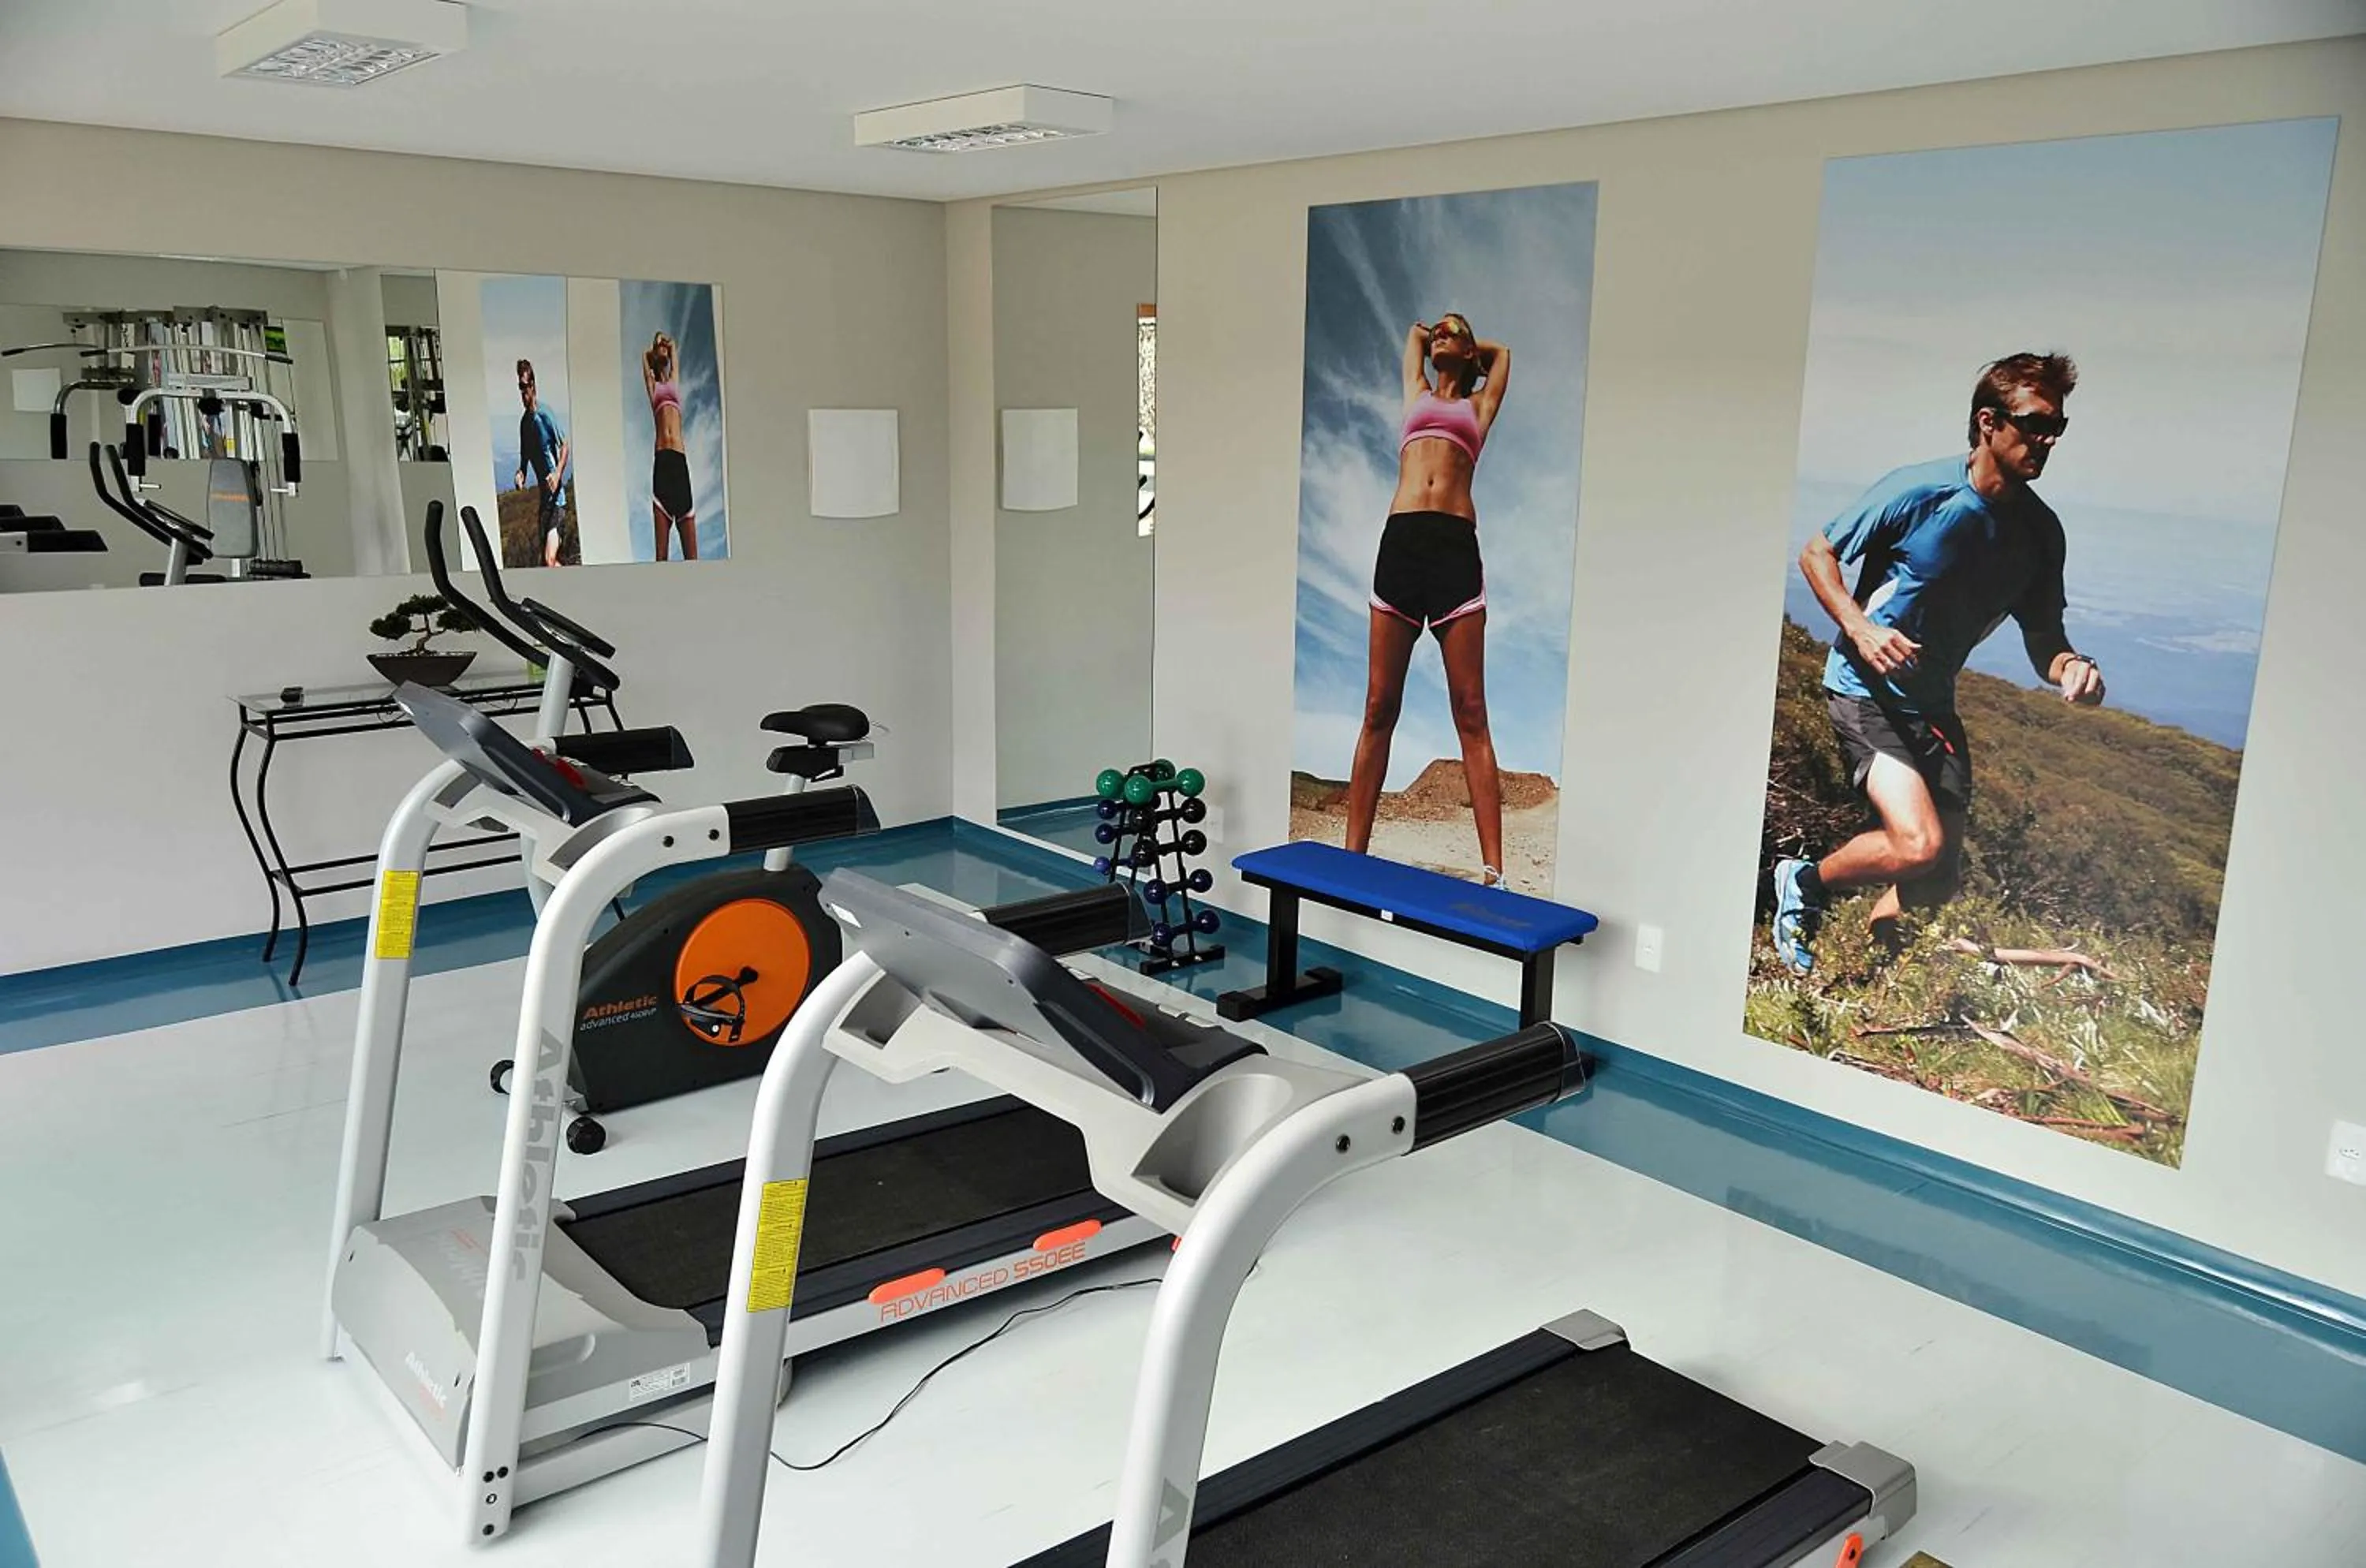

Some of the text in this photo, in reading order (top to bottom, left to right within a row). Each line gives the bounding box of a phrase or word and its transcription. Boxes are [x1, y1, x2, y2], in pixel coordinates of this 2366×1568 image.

[584, 995, 657, 1019] Athletic
[580, 1012, 630, 1031] advanced
[881, 1267, 1009, 1322] ADVANCED
